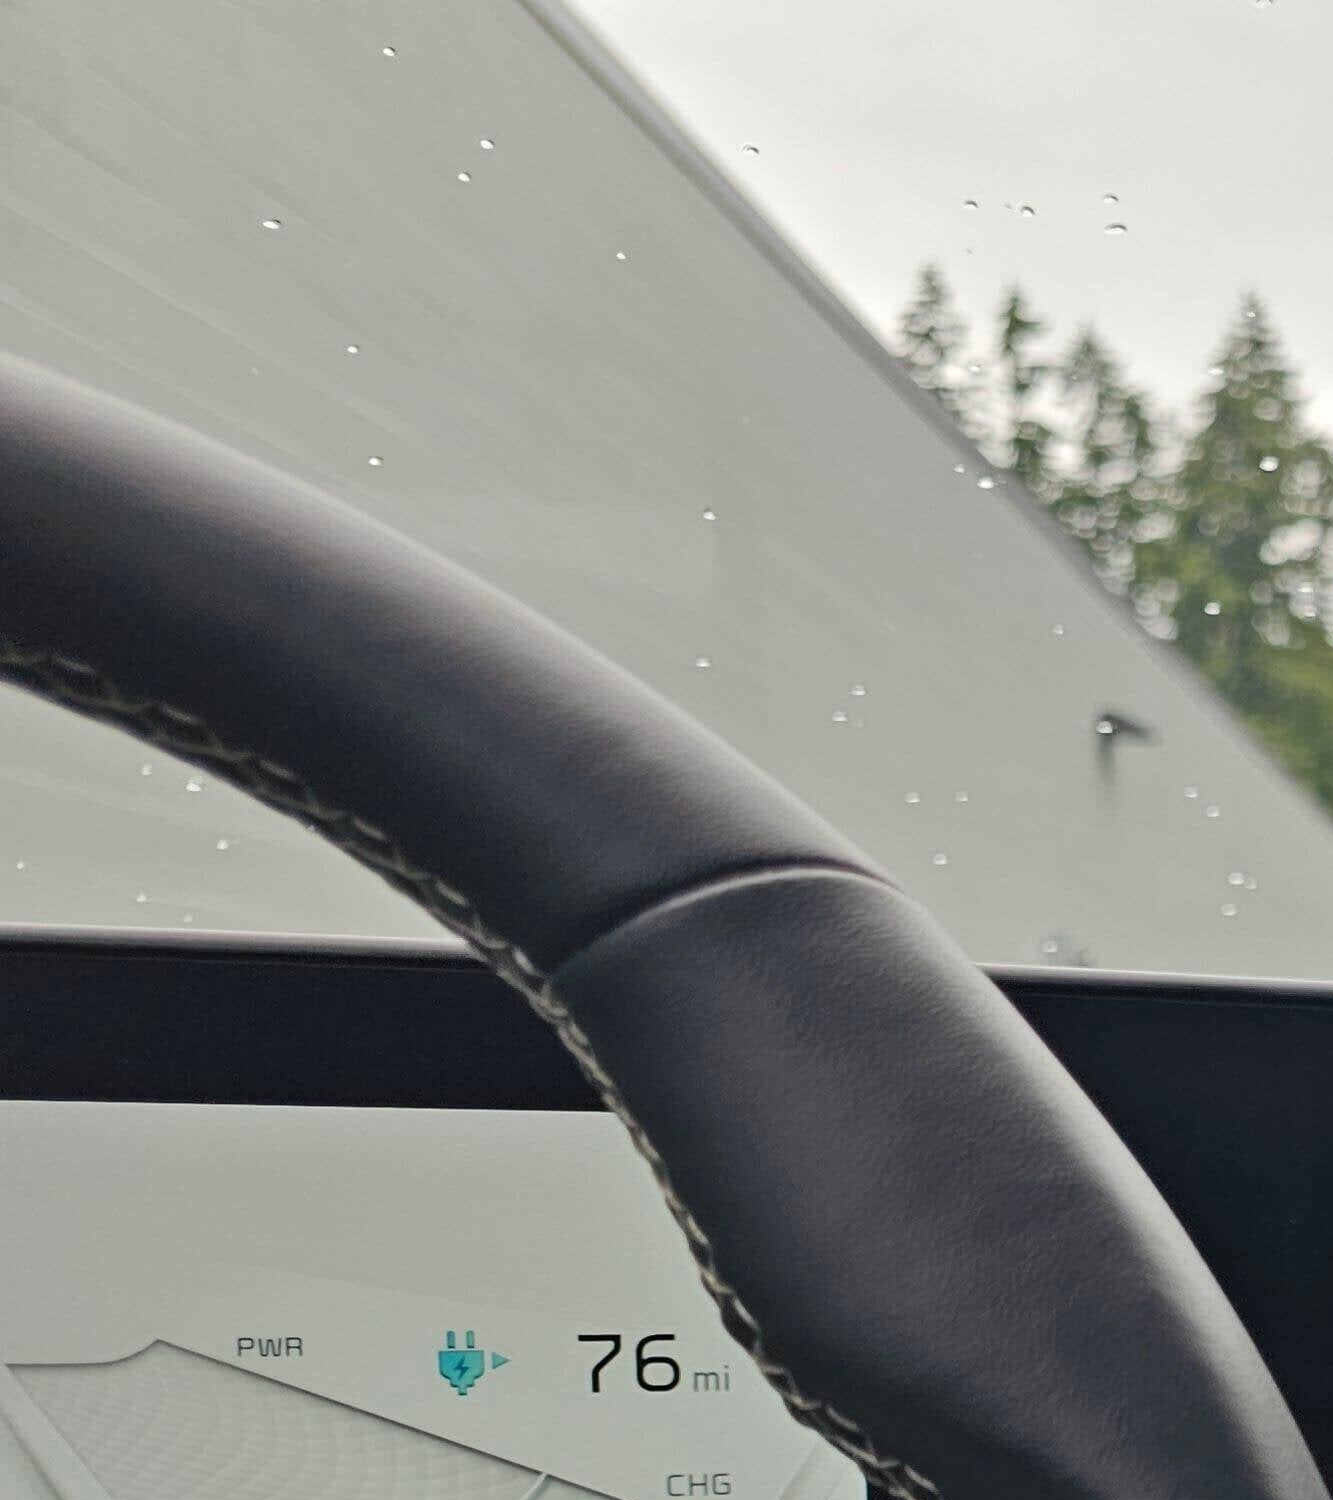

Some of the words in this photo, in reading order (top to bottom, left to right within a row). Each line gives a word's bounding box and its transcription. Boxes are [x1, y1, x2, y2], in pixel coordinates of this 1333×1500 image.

[237, 1337, 302, 1357] PWR
[578, 1334, 681, 1393] 76
[694, 1365, 729, 1392] mi
[667, 1473, 731, 1496] CHG
